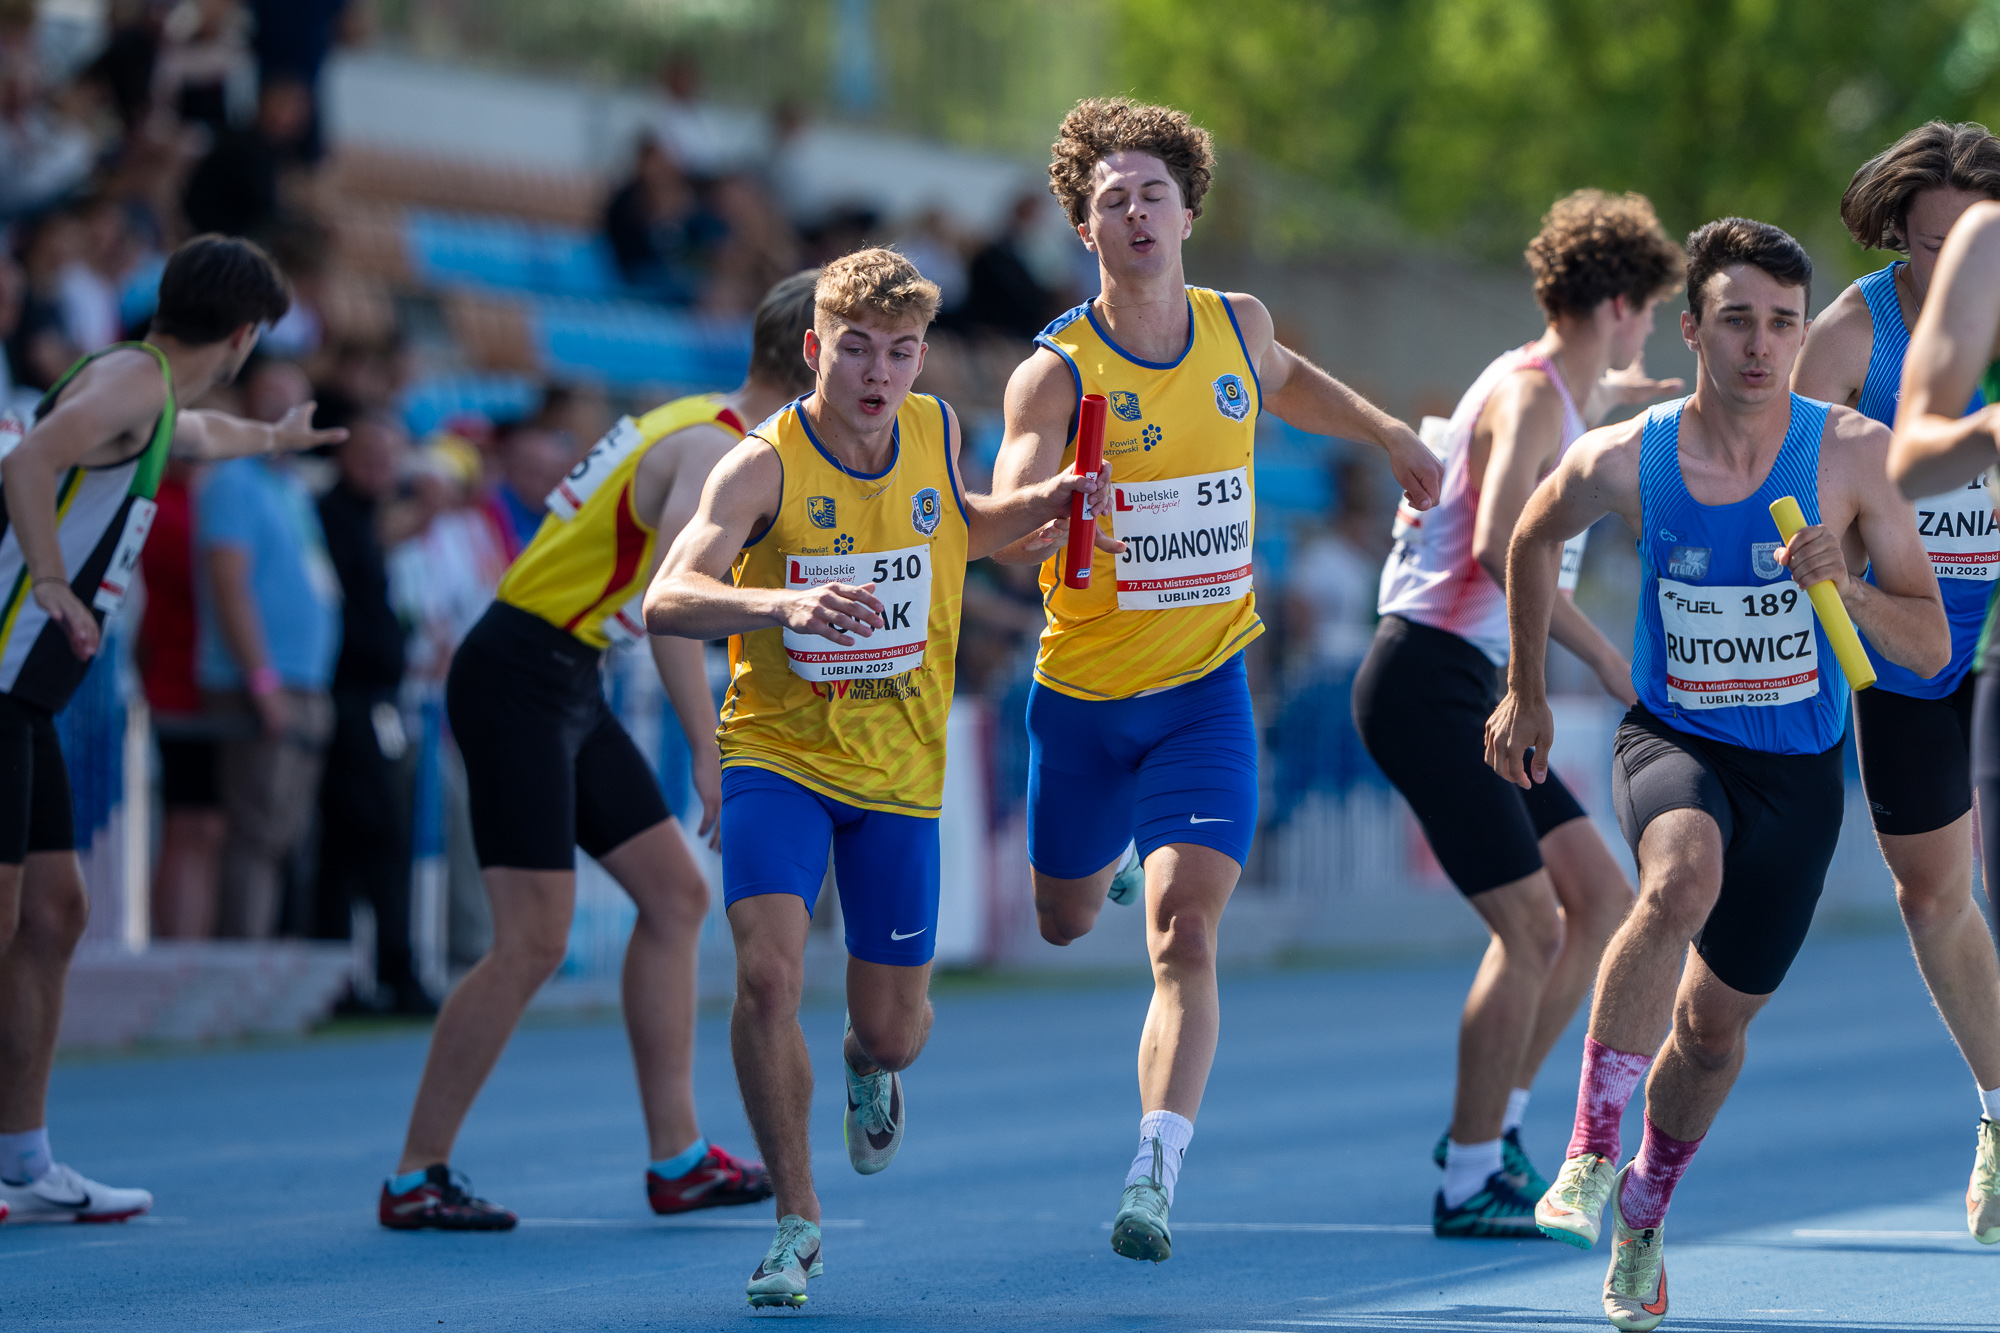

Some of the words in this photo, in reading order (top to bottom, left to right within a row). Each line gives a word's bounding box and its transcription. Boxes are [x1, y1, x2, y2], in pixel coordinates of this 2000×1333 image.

[1110, 438, 1138, 448] Powiat
[1128, 488, 1179, 503] lubelskie
[1197, 476, 1242, 506] 513
[1136, 501, 1161, 515] Smakuj
[801, 545, 829, 554] Powiat
[1121, 519, 1249, 564] STOJANOWSKI
[1928, 554, 1972, 563] strzostwa
[1974, 552, 1999, 562] Polski
[804, 564, 855, 576] lubelskie
[871, 554, 922, 584] 510
[1934, 565, 1954, 575] LIN
[1956, 566, 1988, 576] 2023
[1127, 582, 1140, 591] 77.
[1141, 581, 1162, 590] PZLA
[1164, 576, 1216, 588] Mistrzostwa
[1216, 571, 1238, 583] Polski
[1158, 590, 1200, 603] LUBLIN
[1202, 586, 1231, 598] 2023
[1742, 589, 1798, 617] 189
[1677, 598, 1724, 615] FUEL
[792, 652, 805, 661] 77.
[806, 654, 828, 662] PZLA
[829, 652, 880, 661] Mistrzostwa
[881, 647, 904, 658] Polski
[904, 644, 919, 655] U20
[1666, 629, 1812, 665] RUTOWICZ
[821, 665, 863, 676] LUBLIN
[865, 661, 894, 673] 2023
[1672, 678, 1683, 689] 77.
[1683, 681, 1704, 691] PZLA
[1706, 681, 1761, 691] Mistrzostwa
[1763, 678, 1790, 688] Polski
[1791, 674, 1809, 685] U20
[849, 685, 920, 702] WIELKOPOLSKI
[1700, 694, 1745, 704] LUBLIN
[1747, 692, 1780, 702] 2023
